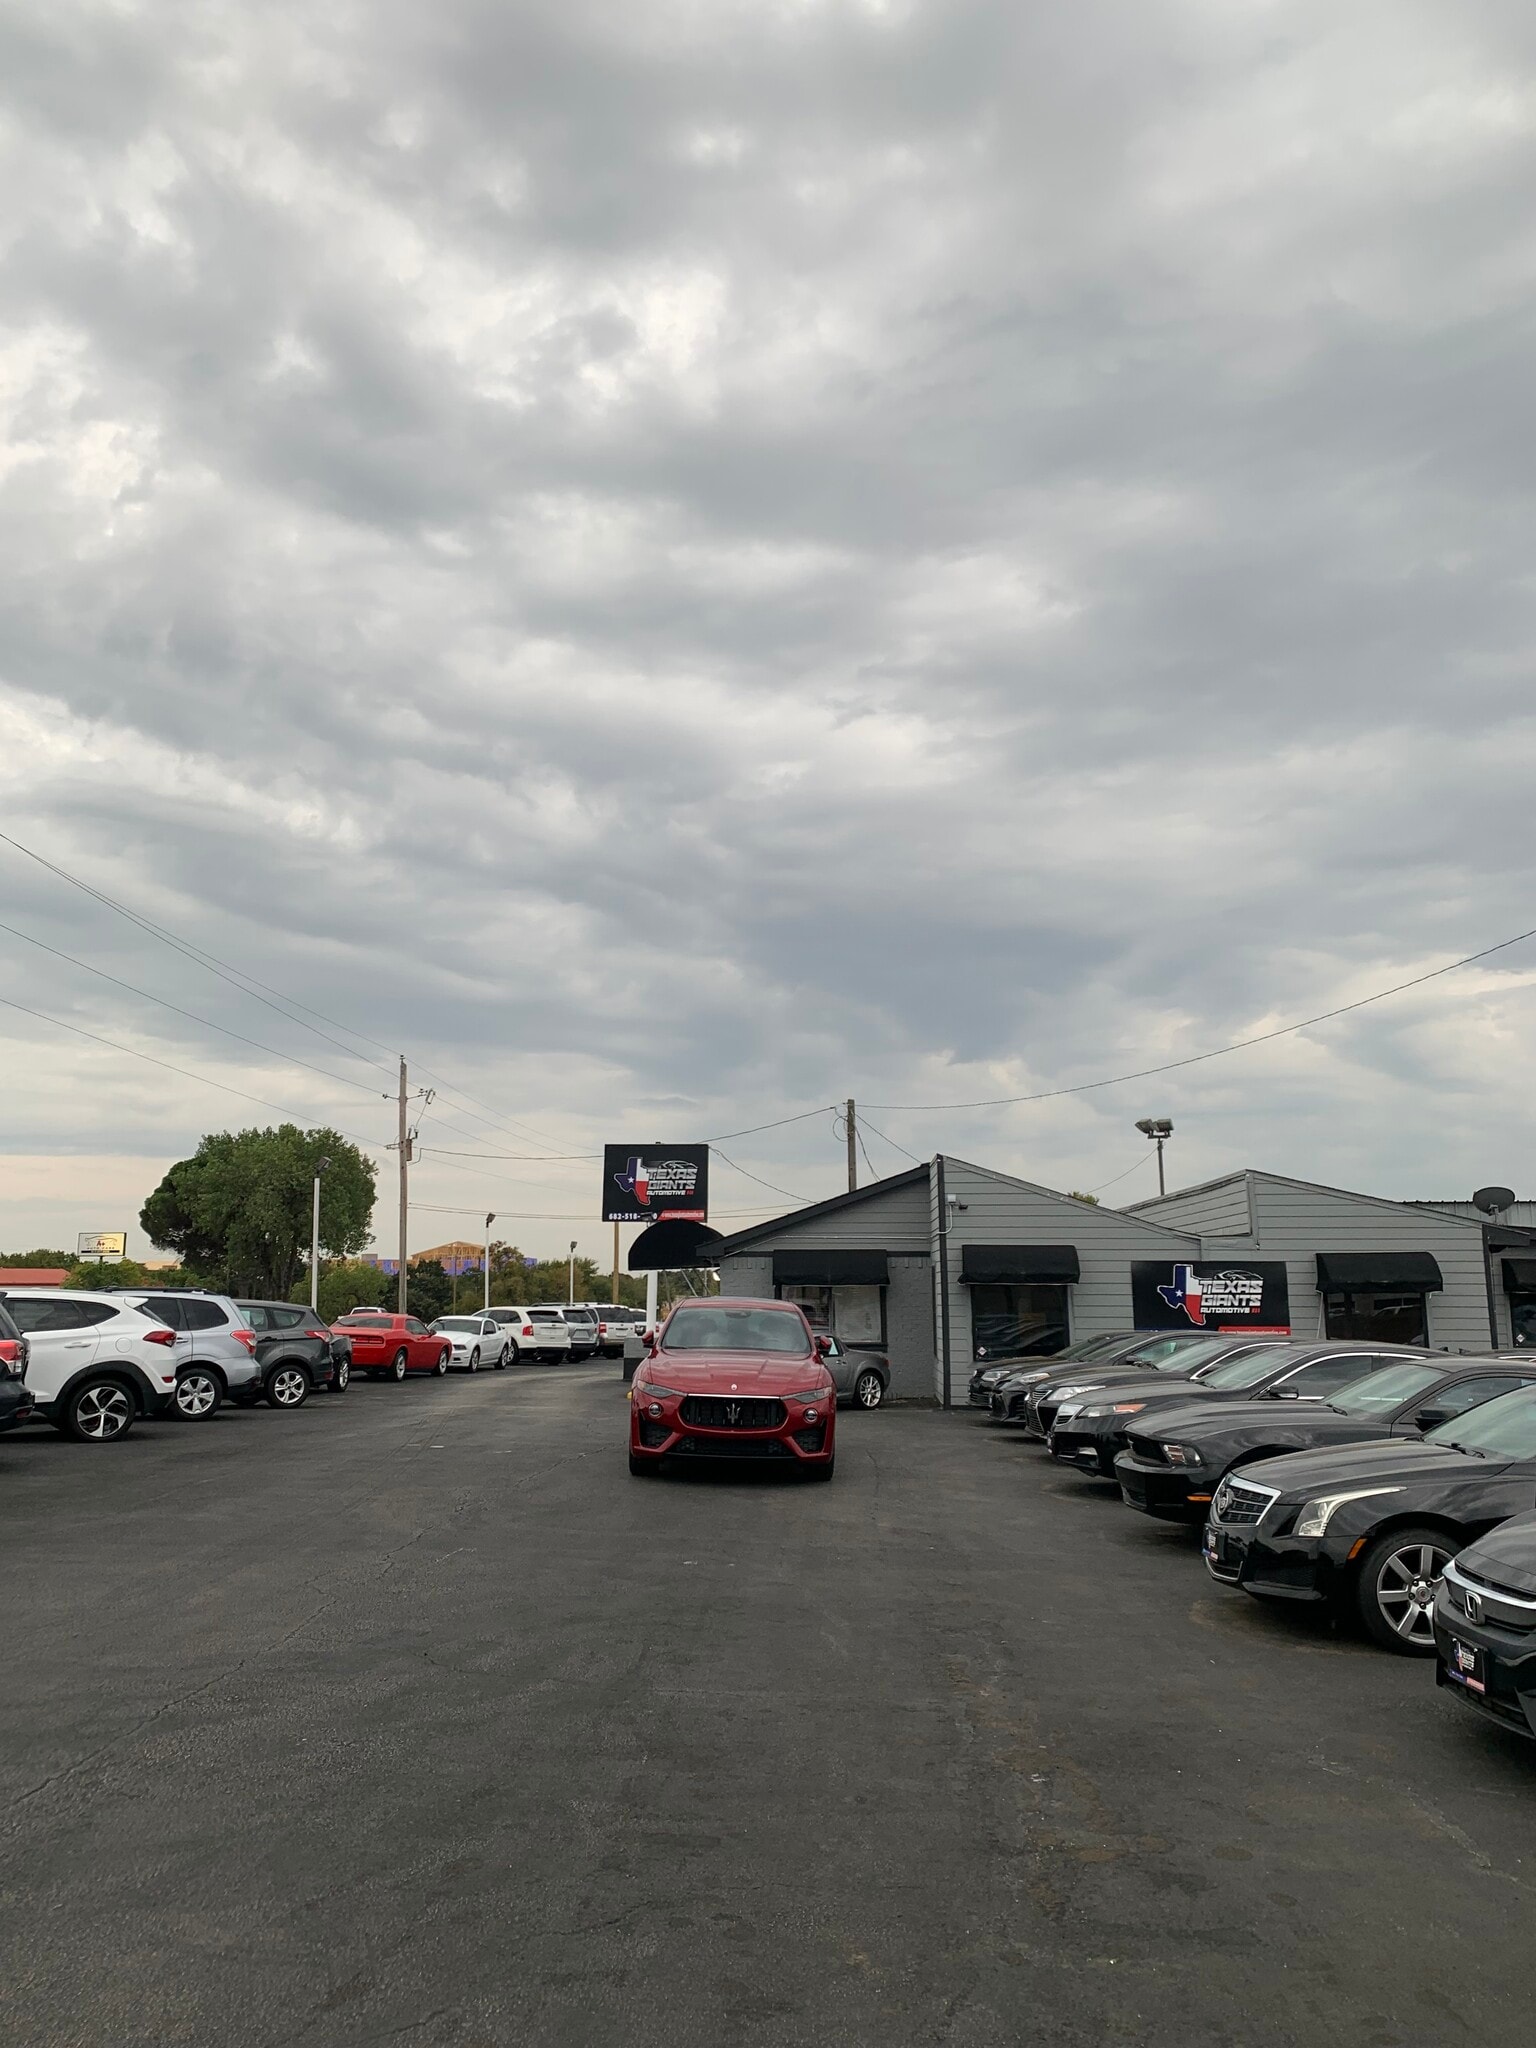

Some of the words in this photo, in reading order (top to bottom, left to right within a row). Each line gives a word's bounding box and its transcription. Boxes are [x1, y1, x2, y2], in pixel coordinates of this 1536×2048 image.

[647, 1168, 698, 1180] TEXAS
[647, 1180, 696, 1190] GIANTS
[1199, 1280, 1264, 1294] TEXAS
[1200, 1294, 1262, 1306] GIANTS
